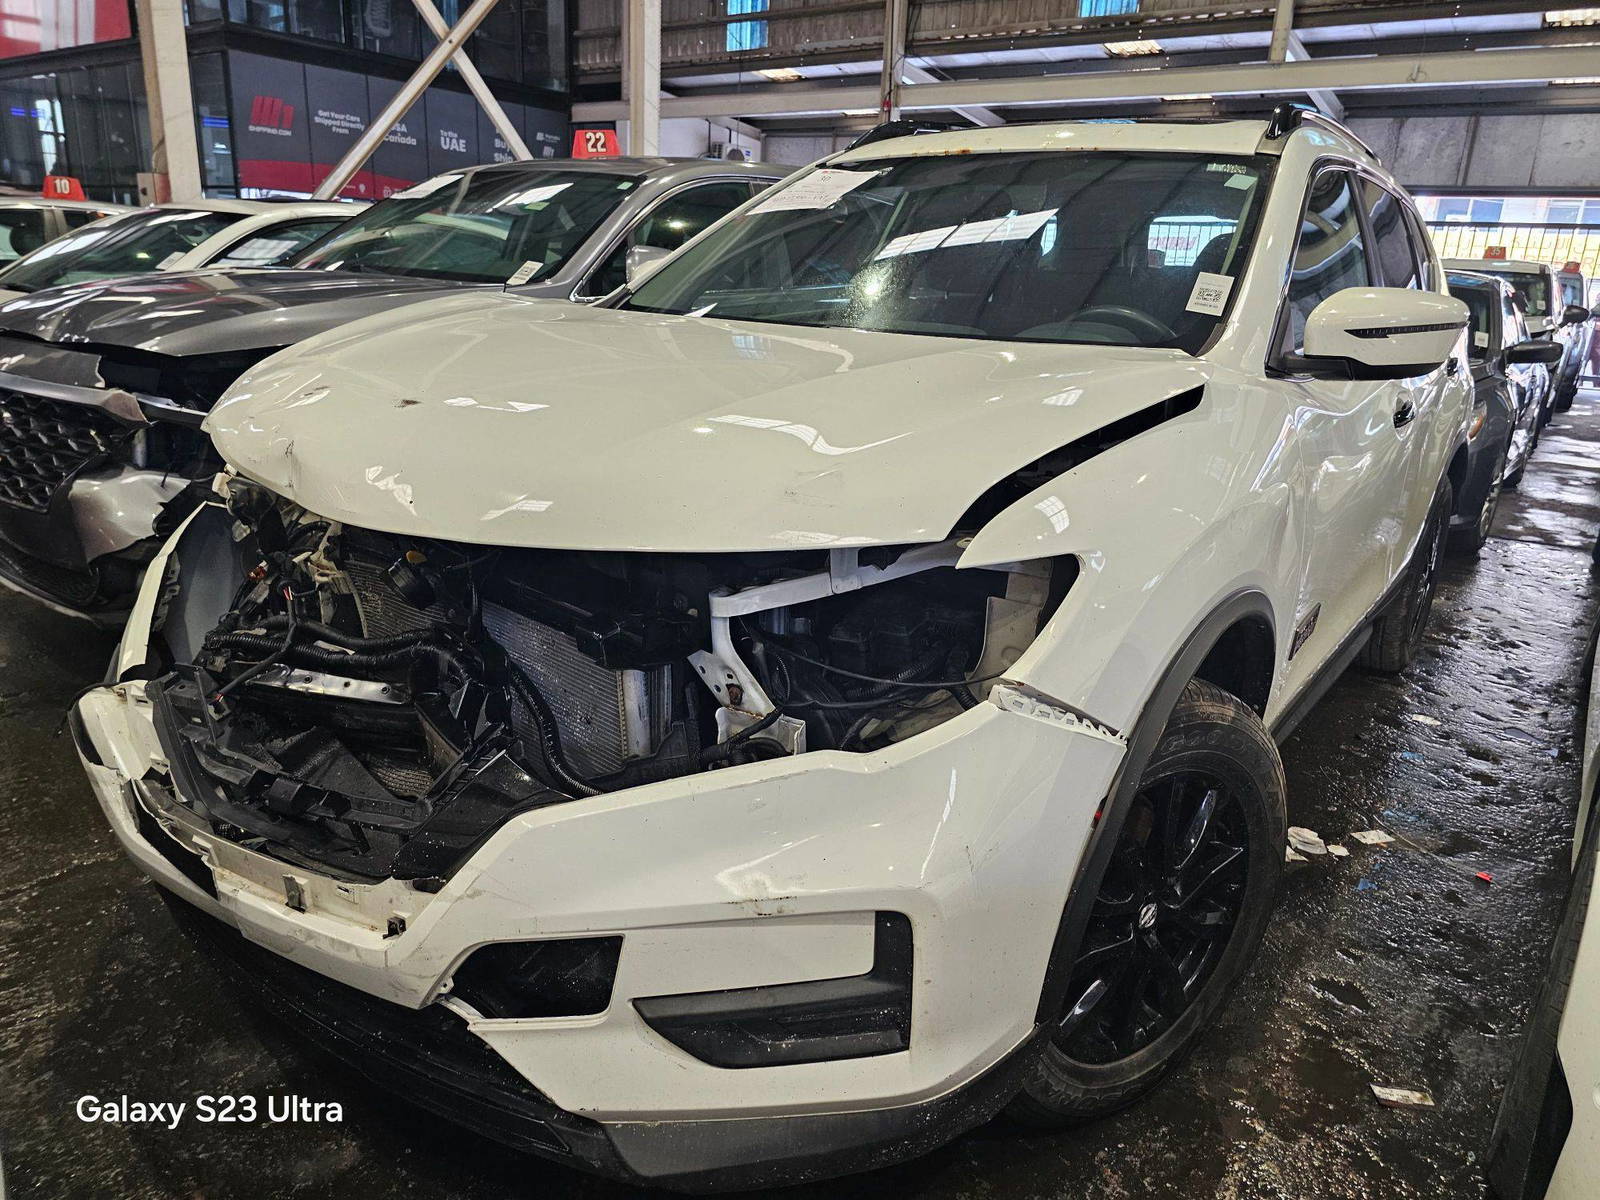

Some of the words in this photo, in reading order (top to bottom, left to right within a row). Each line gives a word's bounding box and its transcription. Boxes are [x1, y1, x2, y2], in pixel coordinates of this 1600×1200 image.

[330, 111, 345, 120] Your
[345, 113, 360, 122] Cars
[314, 116, 340, 126] Shipped
[341, 120, 365, 131] Directly
[332, 126, 349, 135] From
[440, 129, 448, 137] To
[384, 134, 417, 146] Canada
[440, 136, 467, 152] UAE
[585, 132, 607, 153] 22
[54, 178, 70, 194] 10
